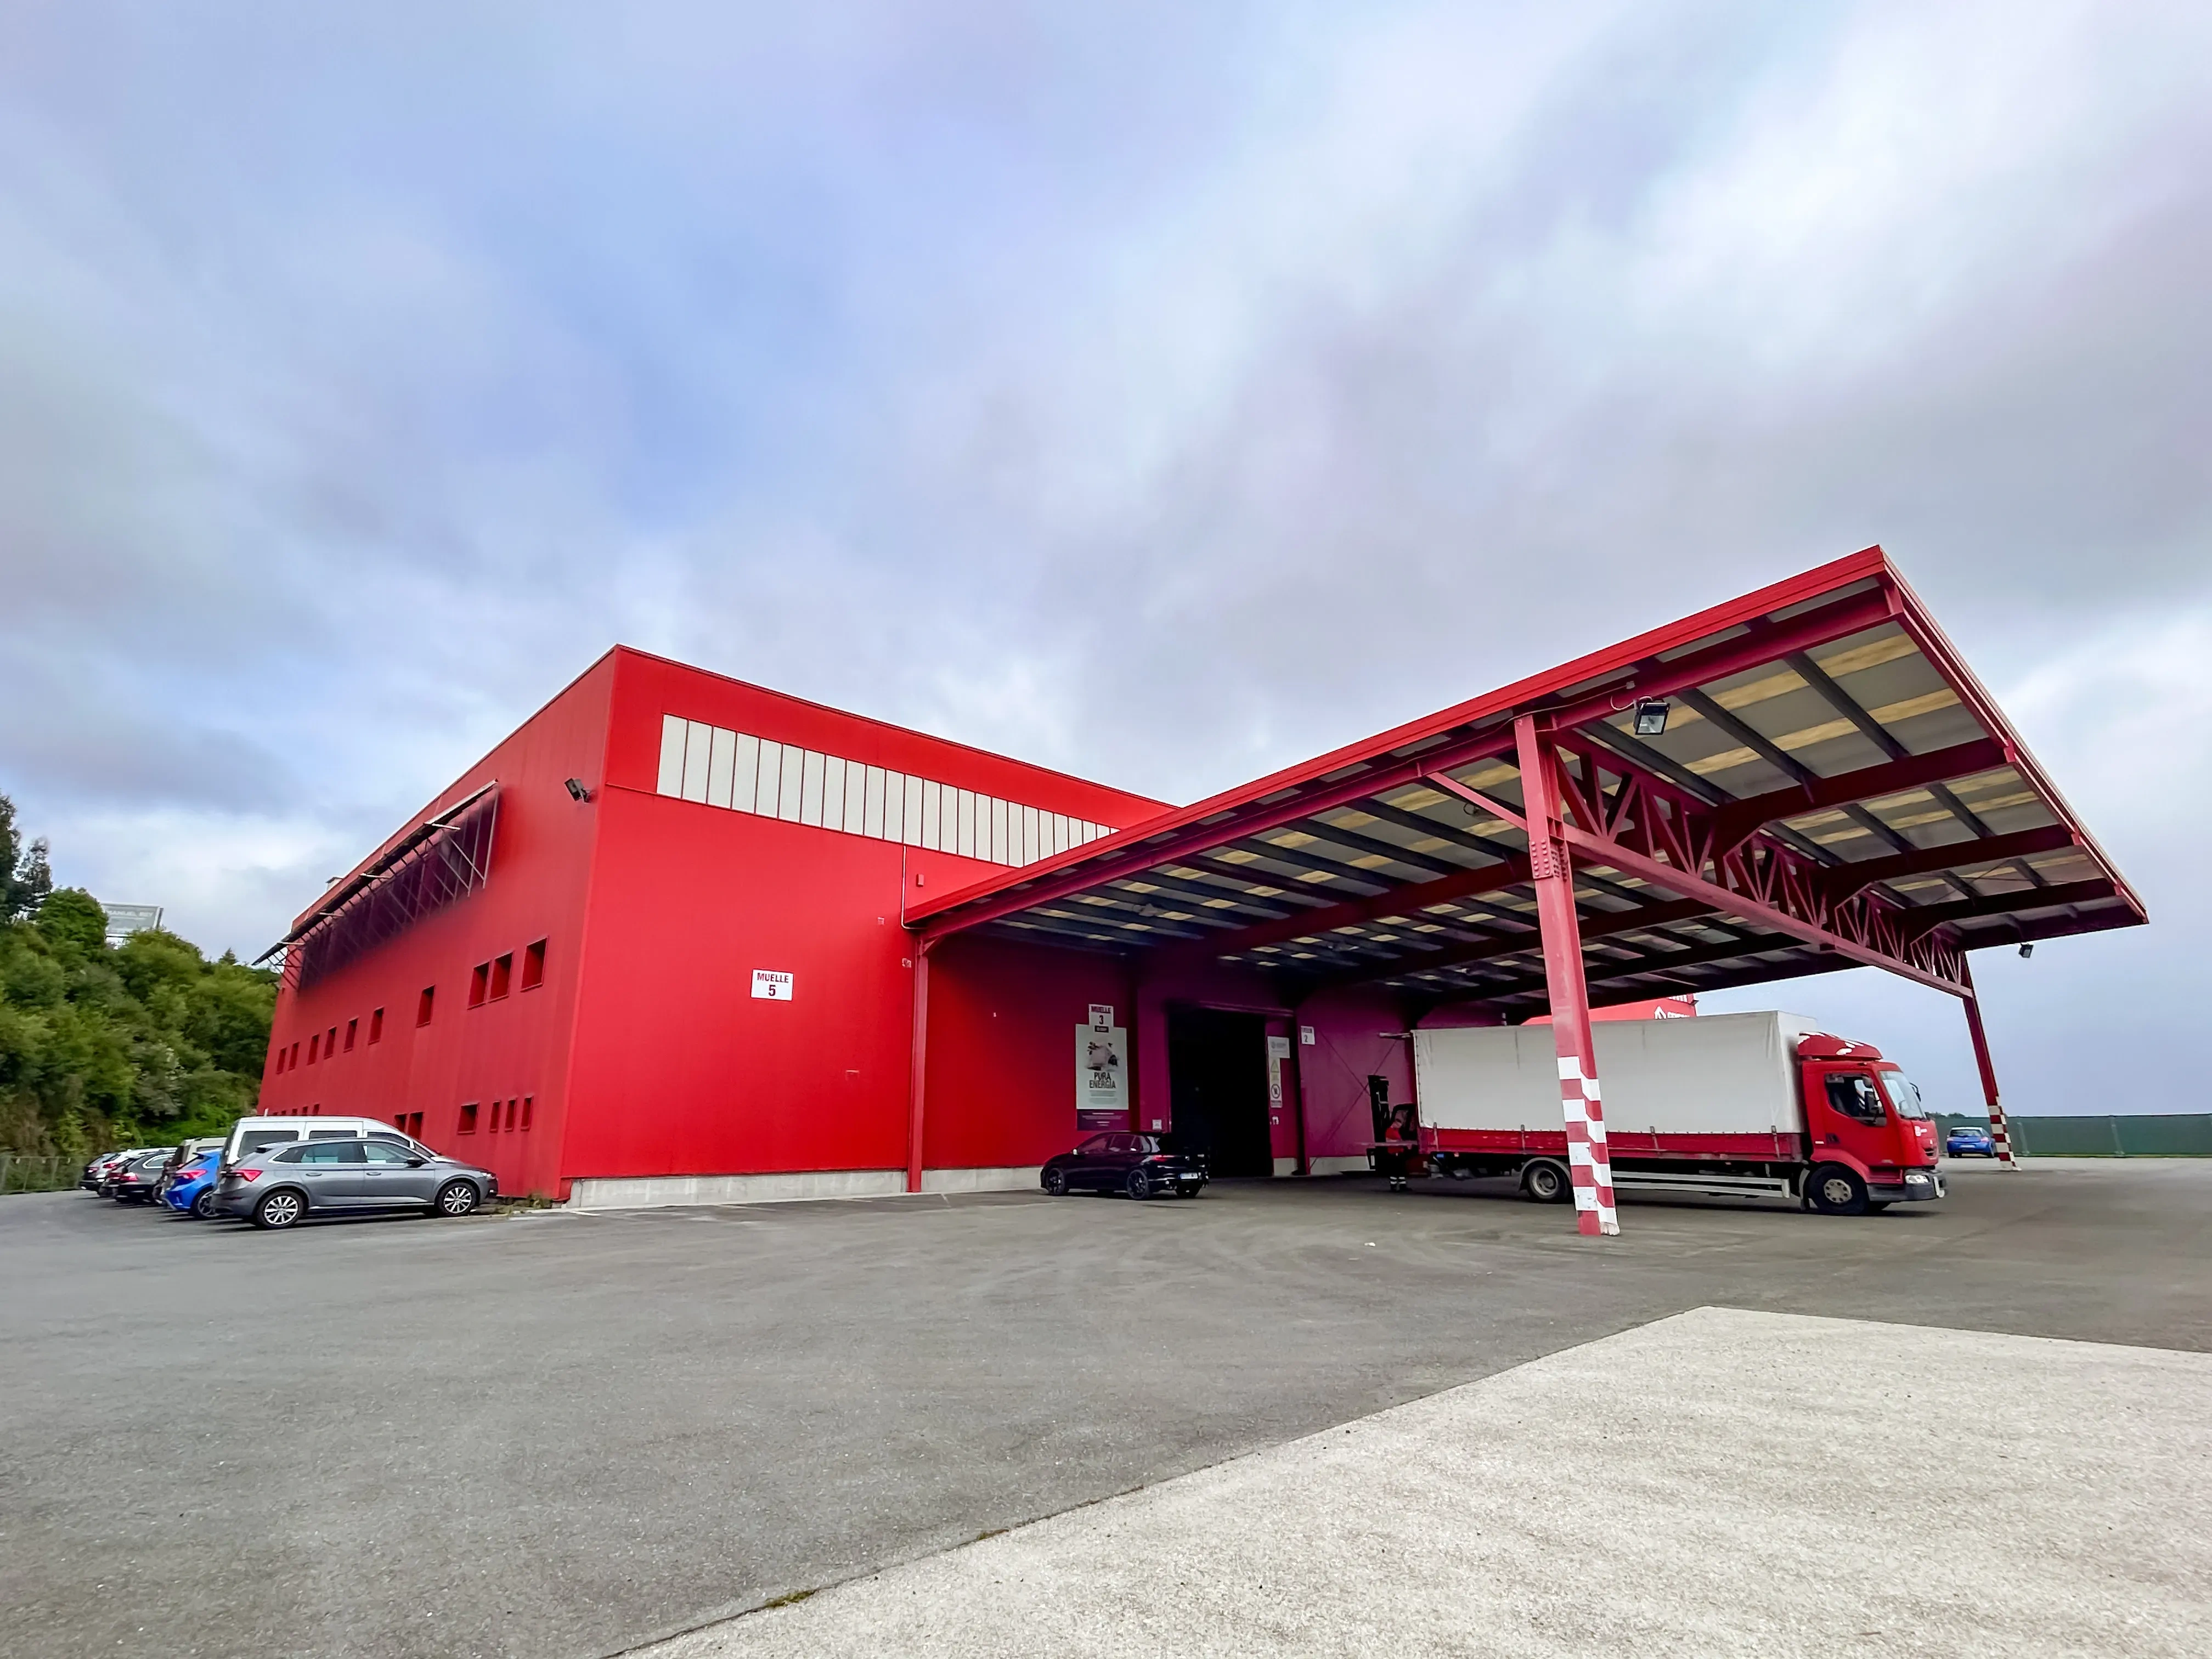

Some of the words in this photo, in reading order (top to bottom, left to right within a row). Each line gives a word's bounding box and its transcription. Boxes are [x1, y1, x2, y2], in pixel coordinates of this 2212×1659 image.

[757, 973, 789, 983] MUELLE
[769, 984, 776, 996] 5
[1099, 1015, 1104, 1025] 3
[1094, 1072, 1111, 1080] PURA
